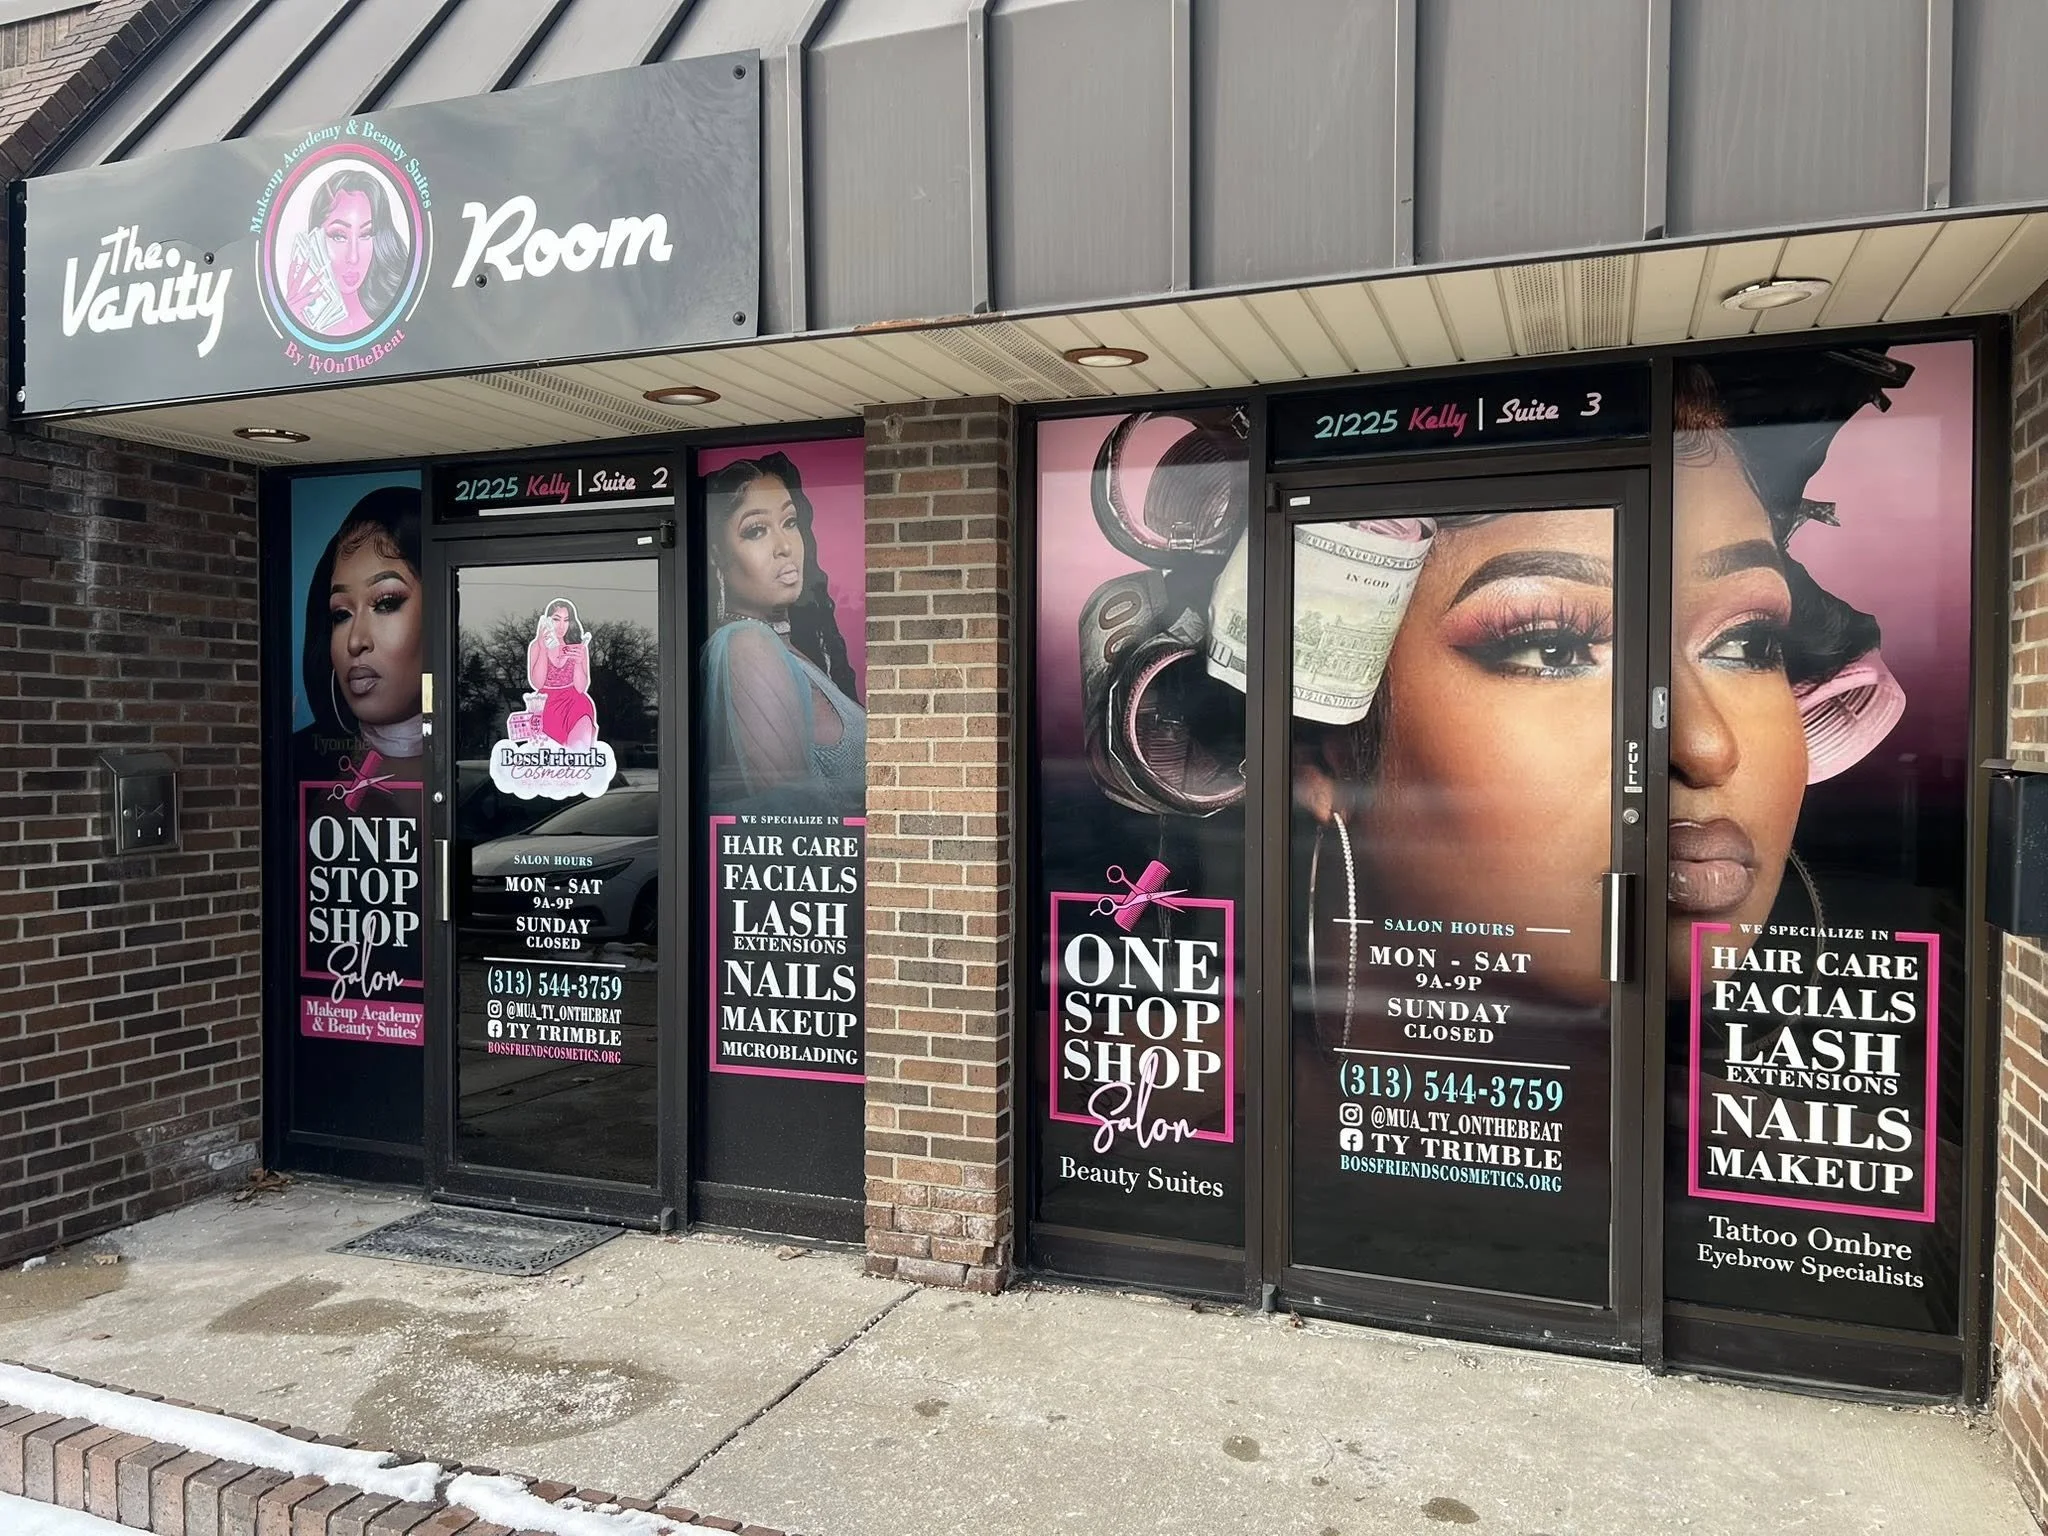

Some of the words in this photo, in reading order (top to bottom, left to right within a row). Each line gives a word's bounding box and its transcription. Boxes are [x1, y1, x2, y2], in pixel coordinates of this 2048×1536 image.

[250, 169, 283, 233] Makeup
[283, 125, 341, 168] Academy
[346, 119, 359, 135] &
[362, 121, 407, 161] Beauty
[405, 158, 432, 209] Suites
[101, 225, 163, 275] The
[452, 195, 673, 288] Room
[63, 248, 232, 357] Vanity
[285, 341, 304, 366] By
[308, 328, 406, 375] TyOnTheBeat
[1408, 403, 1468, 438] Kelly
[1496, 398, 1559, 424] Suite
[1580, 392, 1602, 417] 3
[525, 473, 570, 504] Kelly
[588, 470, 636, 493] Suite
[651, 466, 668, 489] 2
[1346, 572, 1359, 582] IN
[1363, 577, 1390, 589] GOD
[501, 747, 606, 767] BossFriends
[511, 761, 594, 780] Cosmetics
[1628, 742, 1638, 785] PULL
[741, 815, 757, 824] WE
[761, 816, 823, 825] SPECIALIZE
[827, 816, 839, 825] IN
[309, 815, 418, 864] ONE
[723, 835, 784, 856] HAIR
[792, 836, 858, 858] CARE
[514, 855, 550, 865] SALON
[554, 855, 593, 867] HOURS
[724, 864, 857, 894] FACIALS
[310, 866, 418, 905] STOP
[505, 877, 546, 893] MON
[568, 879, 603, 895] SAT
[533, 897, 574, 910] 9A-9P
[309, 907, 419, 947] SHOP
[516, 917, 590, 934] SUNDAY
[733, 899, 848, 939] LASH
[1384, 918, 1443, 933] SALON
[1450, 921, 1515, 937] HOURS
[1739, 923, 1763, 935] WE
[1769, 925, 1864, 940] SPECIALIZE
[1871, 929, 1889, 941] IN
[327, 915, 404, 1004] Salon
[526, 936, 581, 950] CLOSED
[733, 935, 847, 955] EXTENSIONS
[1369, 945, 1437, 968] MON
[1474, 951, 1532, 974] SAT
[723, 959, 856, 1003] NAILS
[1064, 933, 1219, 995] ONE
[1415, 973, 1483, 991] 9A-9P
[1711, 946, 1804, 974] HAIR
[1816, 952, 1919, 981] CARE
[487, 966, 532, 998] (313)
[538, 972, 622, 1001] 544-3759
[1711, 980, 1916, 1024] FACIALS
[306, 1000, 357, 1021] Makeup
[361, 1004, 423, 1027] Academy
[312, 1017, 324, 1032] &
[328, 1017, 374, 1040] Beauty
[377, 1022, 417, 1039] Suites
[506, 1001, 622, 1025] @MUA_TY_ONTHEBEAT
[721, 1005, 857, 1038] MAKEUP
[1064, 990, 1221, 1043] STOP
[1387, 998, 1511, 1025] SUNDAY
[506, 1023, 536, 1039] TY
[537, 1025, 622, 1046] TRIMBLE
[1403, 1023, 1494, 1044] CLOSED
[1724, 1022, 1901, 1077] LASH
[487, 1042, 622, 1065] BOSSFRIENDSCOSMETICS.ORG
[722, 1041, 858, 1065] MICROBLADING
[1063, 1038, 1222, 1093] SHOP
[1339, 1059, 1412, 1103] (313)
[1423, 1069, 1564, 1112] 544-3759
[1726, 1065, 1898, 1096] EXTENSIONS
[1088, 1052, 1198, 1154] Salon
[1370, 1105, 1563, 1143] @MUA_TY_ONTHEBEAT
[1711, 1092, 1913, 1153] NAILS
[1371, 1132, 1411, 1156] TY
[1420, 1137, 1563, 1171] TRIMBLE
[1707, 1146, 1914, 1195] MAKEUP
[1060, 1156, 1140, 1194] Beauty
[1147, 1166, 1224, 1198] Suites
[1340, 1154, 1562, 1193] BOSSFRIENDSCOSMETICS.ORG
[1708, 1215, 1798, 1247] Tattoo
[1807, 1227, 1913, 1261] Ombre
[1697, 1243, 1794, 1273] Eyebrow
[1801, 1256, 1924, 1289] Specialists
